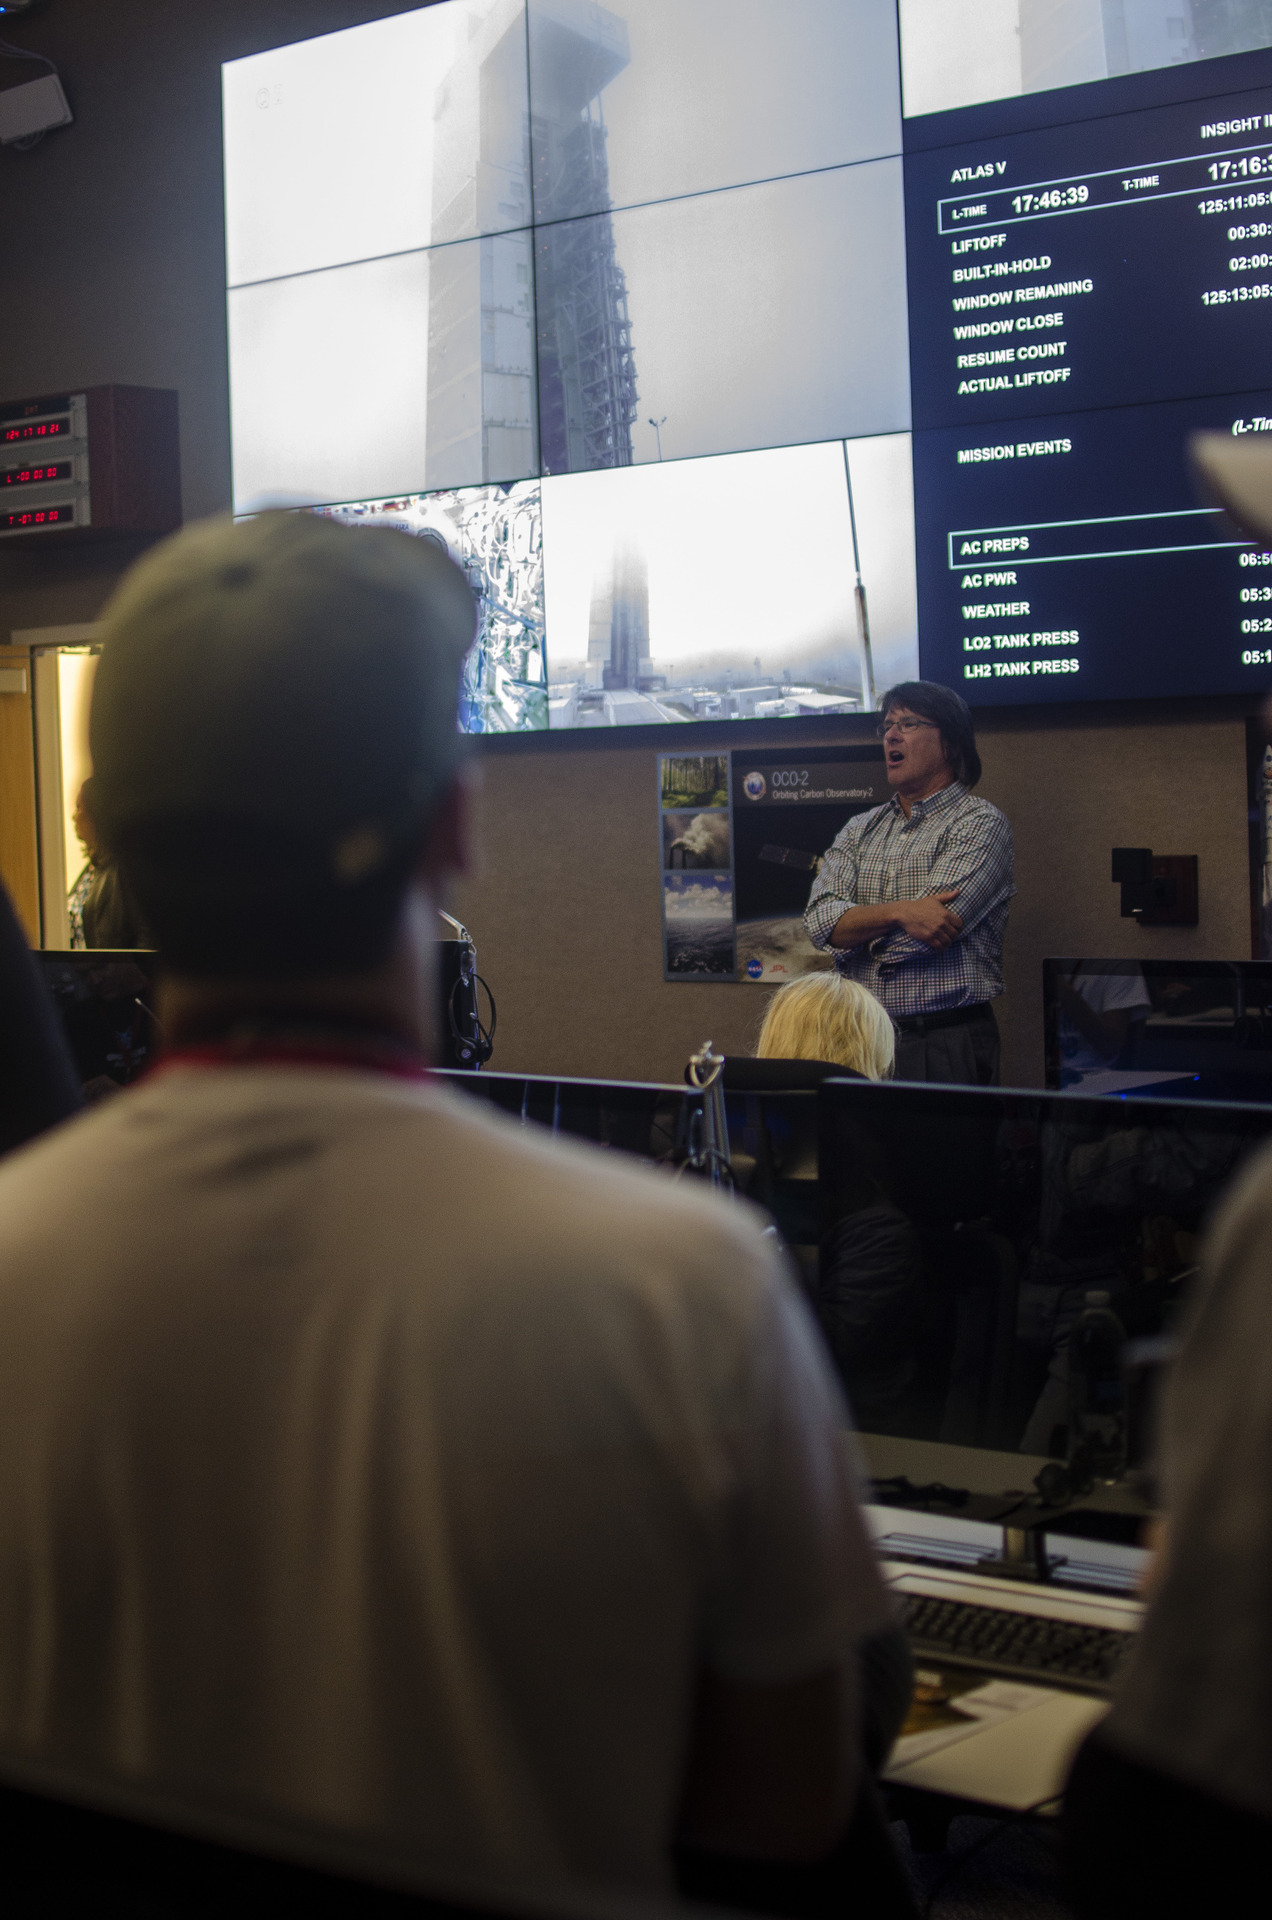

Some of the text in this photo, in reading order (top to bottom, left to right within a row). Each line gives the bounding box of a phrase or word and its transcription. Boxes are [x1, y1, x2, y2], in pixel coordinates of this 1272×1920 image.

[1201, 116, 1262, 138] INSIGHT
[950, 161, 1007, 183] ATLAS V
[952, 205, 987, 220] L-TIME
[1012, 185, 1089, 213] 17:46:39
[1122, 176, 1160, 191] T-TIME
[952, 193, 1272, 255] LIFTOFF 125:11:05:
[952, 224, 1272, 283] BUILT-IN-HOLD 00:30:
[952, 291, 1013, 311] WINDOW
[1015, 279, 1093, 302] REMAINING
[953, 320, 1014, 340] WINDOW
[1015, 313, 1064, 331] CLOSE
[957, 342, 1067, 368] RESUME COUNT
[958, 368, 1071, 394] ACTUAL LIFTOFF
[957, 439, 1072, 464] MISSION EVENTS
[34, 470, 42, 479] 00
[47, 468, 56, 477] 00
[35, 513, 44, 522] 00
[49, 511, 58, 520] 00
[960, 537, 1029, 556] AC PREPS
[961, 553, 1272, 589] AC PWR 06:5
[962, 587, 1272, 619] WEATHER 05:3
[963, 637, 991, 651] LO2
[993, 634, 1030, 649] TANK
[1032, 631, 1080, 647] PRESS
[964, 664, 991, 679] LH2
[993, 662, 1030, 677] TANK
[1032, 659, 1080, 675] PRESS
[772, 771, 809, 786] OCO-2
[773, 787, 873, 800] Orbiting Carbon Observatory-2
